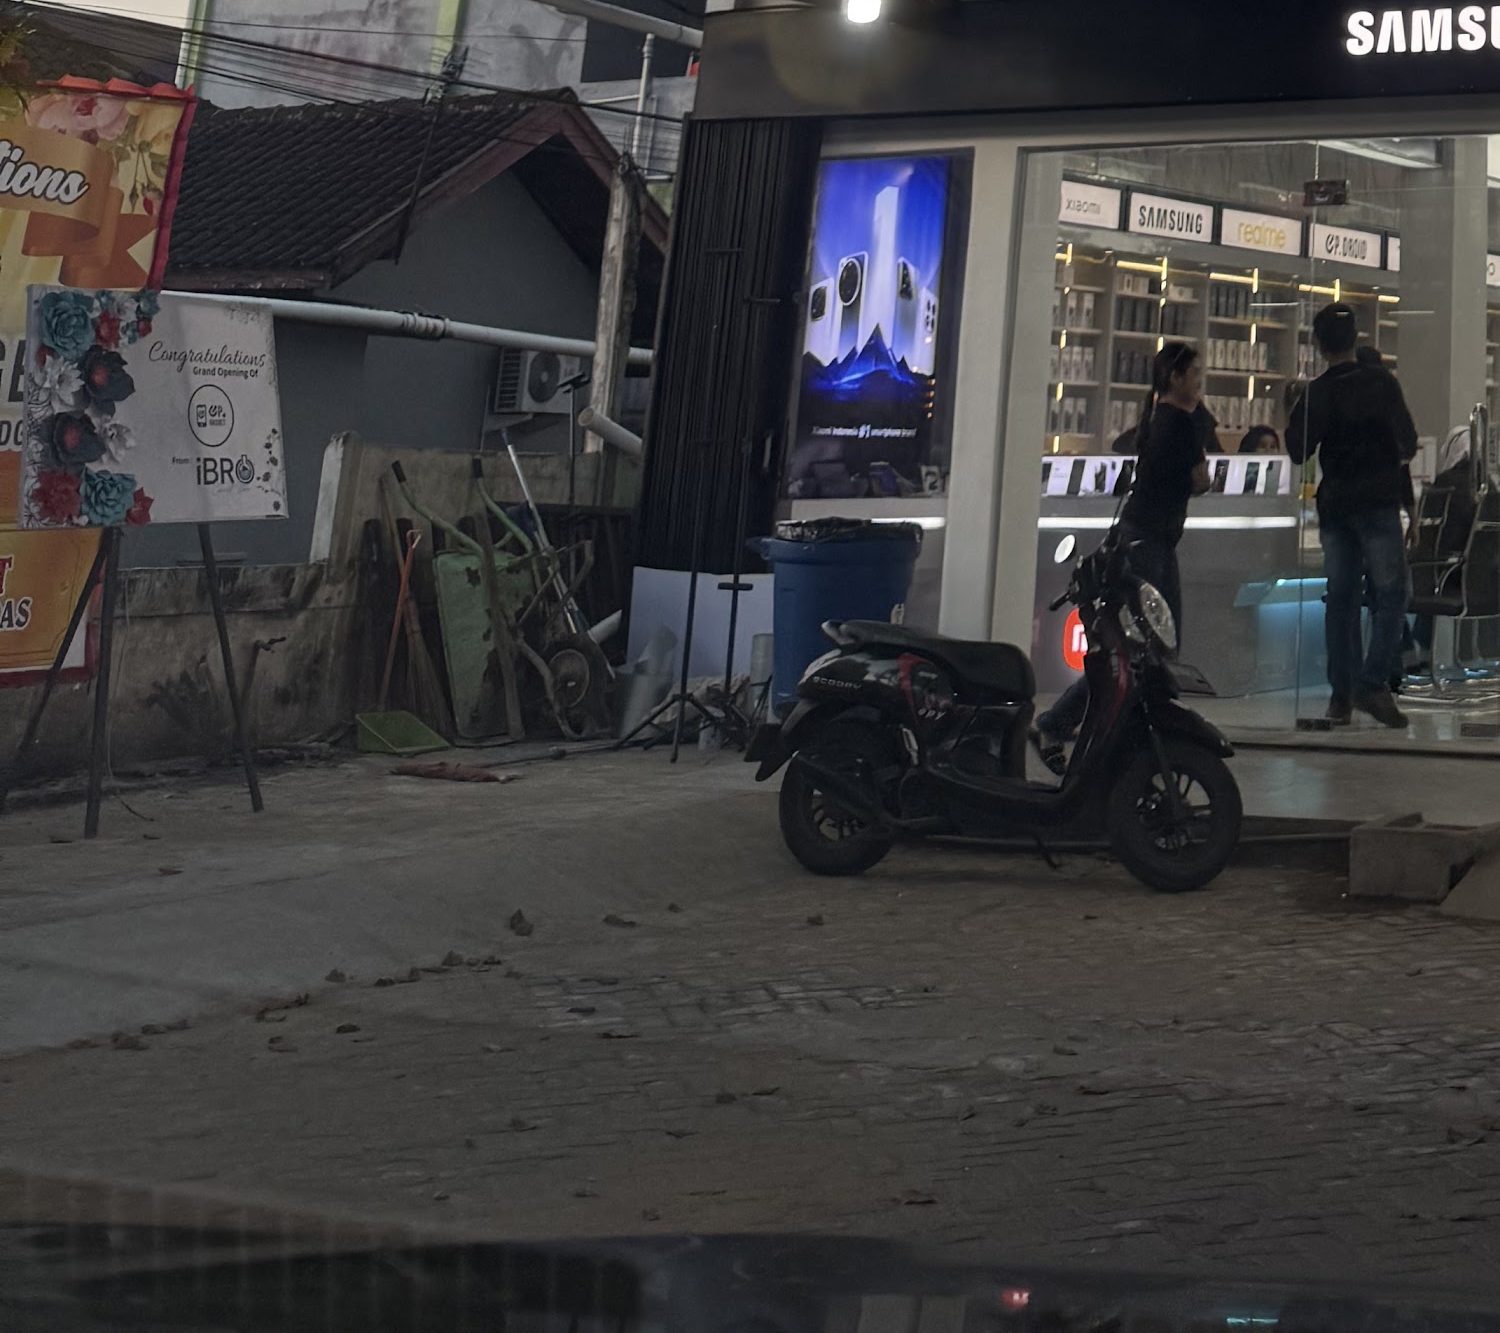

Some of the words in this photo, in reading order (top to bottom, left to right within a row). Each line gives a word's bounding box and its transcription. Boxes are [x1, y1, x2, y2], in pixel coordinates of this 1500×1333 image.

[1138, 204, 1203, 234] SAMSUNG
[1237, 220, 1286, 250] realme
[148, 341, 266, 373] Congratulations
[192, 366, 216, 376] Grand
[217, 368, 248, 380] Opening
[250, 369, 259, 378] Of
